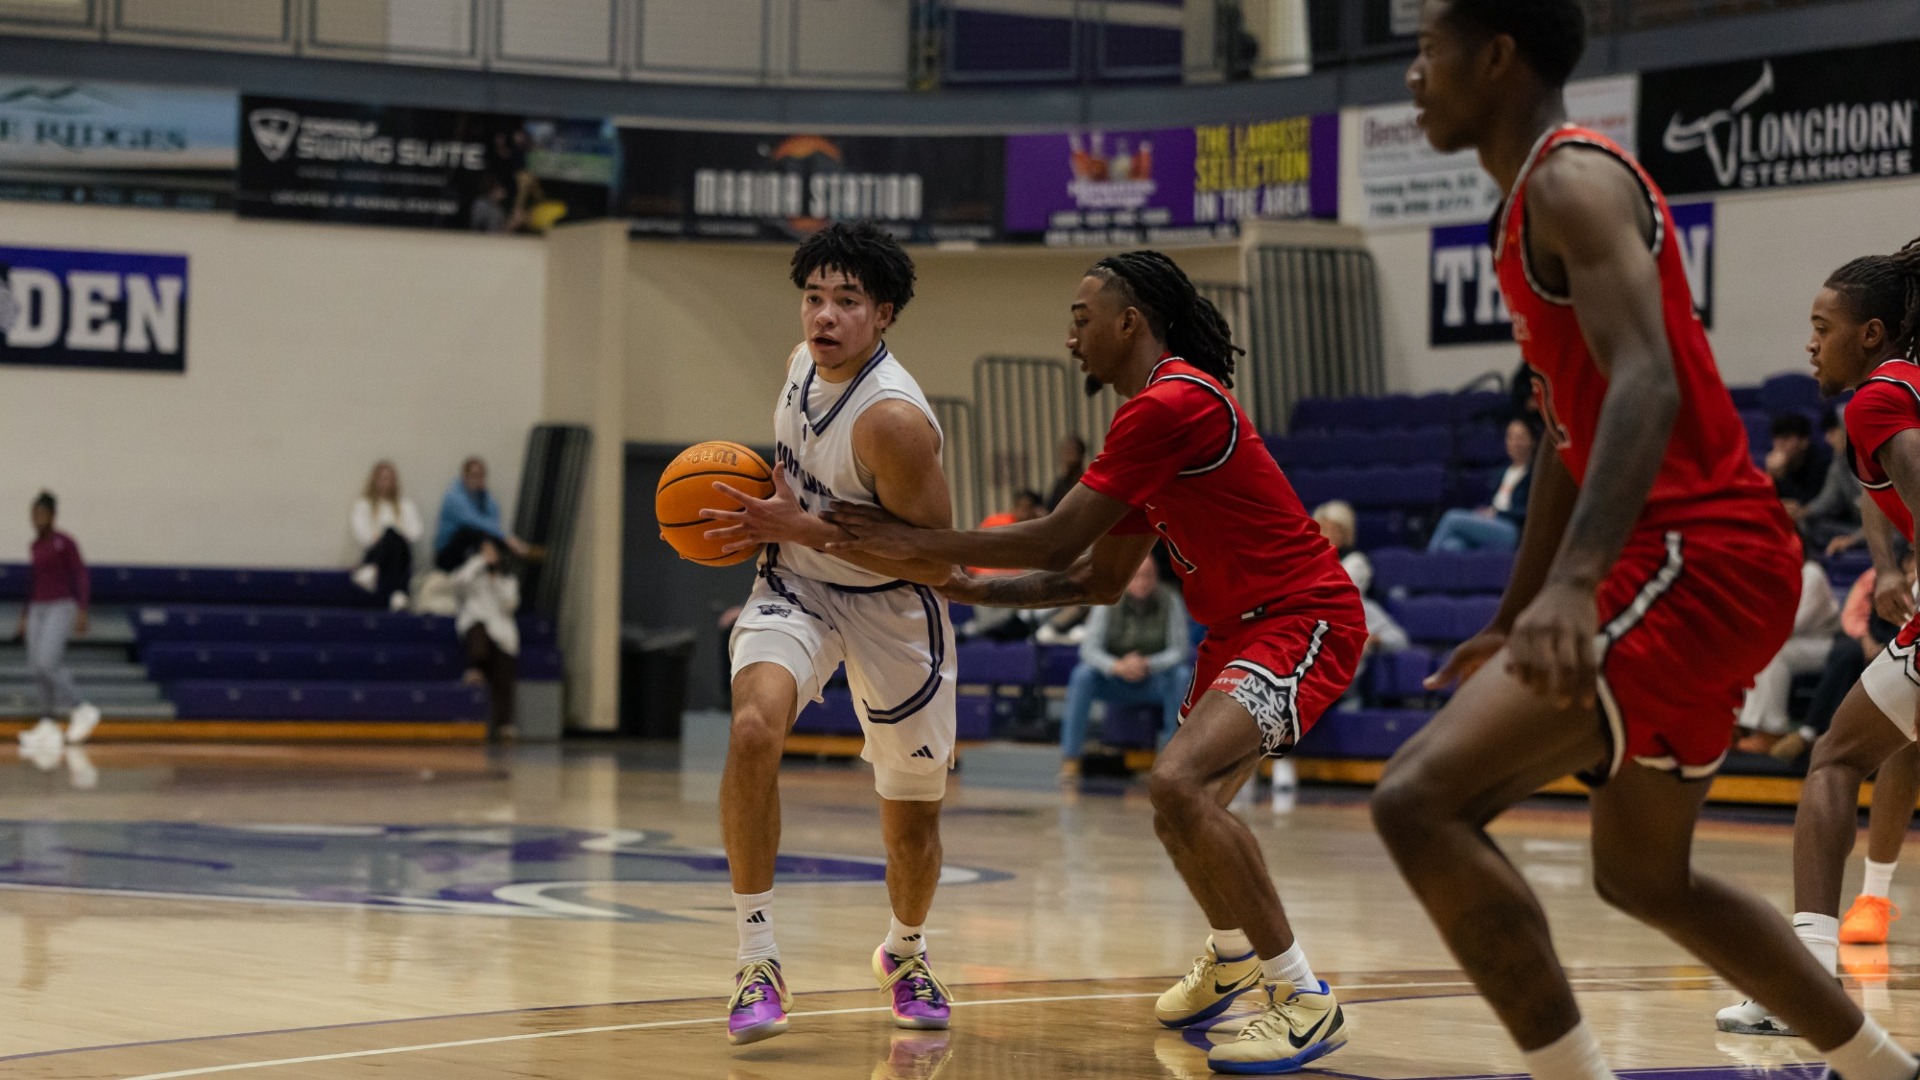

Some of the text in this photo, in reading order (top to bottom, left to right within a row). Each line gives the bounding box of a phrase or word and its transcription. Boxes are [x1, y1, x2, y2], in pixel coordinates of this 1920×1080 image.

[36, 118, 188, 152] RIDGES
[1740, 99, 1914, 162] LONGHORN
[297, 134, 487, 170] SWING SUITE
[1195, 150, 1311, 192] SELECTION
[1739, 150, 1912, 188] STEAKHOUSE
[809, 173, 923, 221] STATION
[1260, 183, 1311, 217] AREA
[1433, 246, 1512, 328] TH
[6, 267, 183, 354] DEN
[668, 449, 738, 467] Wil
